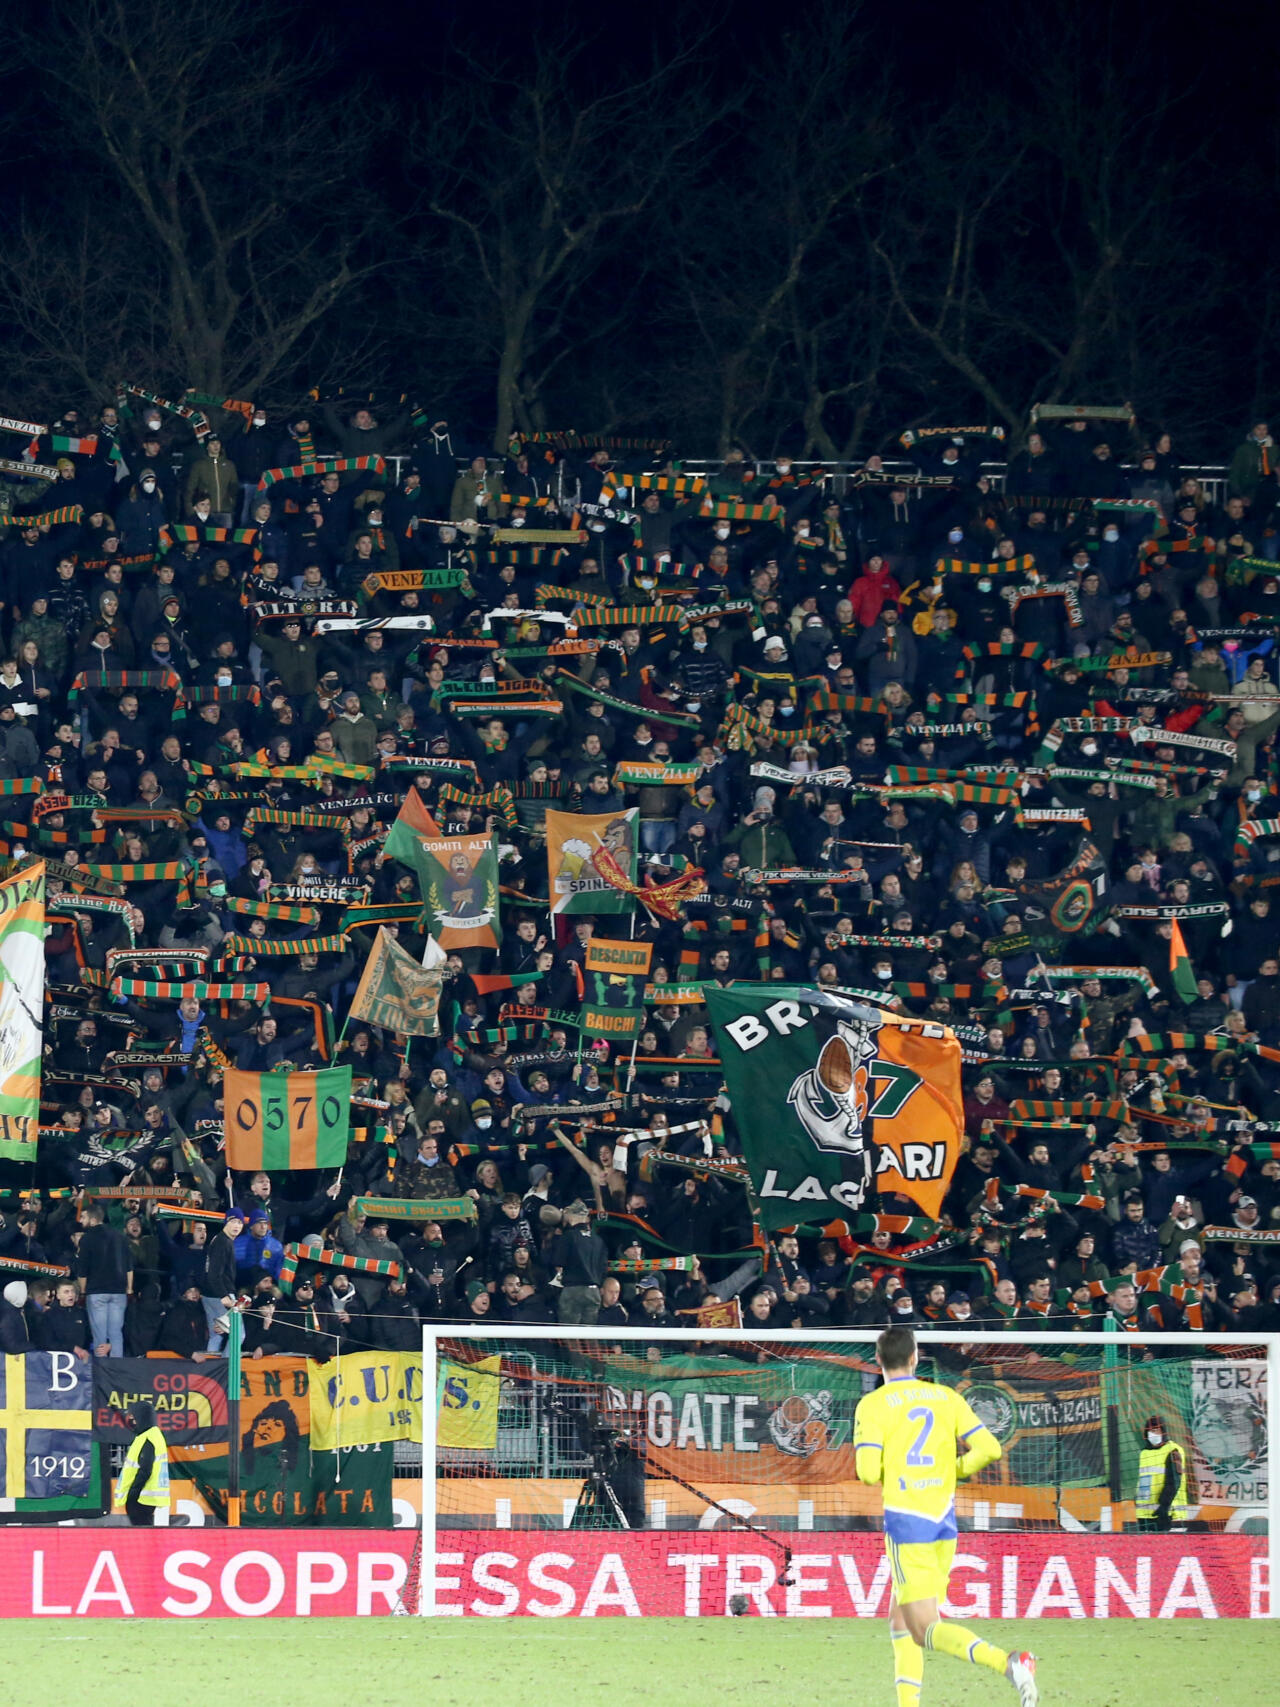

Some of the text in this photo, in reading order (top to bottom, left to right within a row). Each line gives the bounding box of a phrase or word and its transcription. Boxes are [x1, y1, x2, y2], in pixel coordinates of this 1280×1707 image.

[9, 461, 59, 479] sunday
[380, 570, 466, 589] VENEZIA FC
[405, 756, 462, 770] VENEZIA
[625, 764, 685, 781] VENEZIA
[319, 792, 393, 810] VENEZIA FC
[422, 839, 492, 852] GOMITI ALTI
[340, 874, 359, 886] ALTI
[286, 885, 347, 900] VINCERE
[732, 898, 752, 909] ALTI
[1122, 903, 1225, 918] CURVA SUD
[677, 985, 696, 999] FC
[112, 1052, 192, 1065] VENEZIAMESTRE
[236, 1095, 342, 1132] 0570
[32, 1264, 66, 1280] 1987
[47, 1350, 78, 1392] B
[153, 1374, 186, 1392] GO
[106, 1391, 186, 1411] AHEAD
[906, 1407, 934, 1466] 2
[30, 1455, 85, 1479] 1912
[32, 1549, 1224, 1620] LA SOPRESSA TREVGIANA
